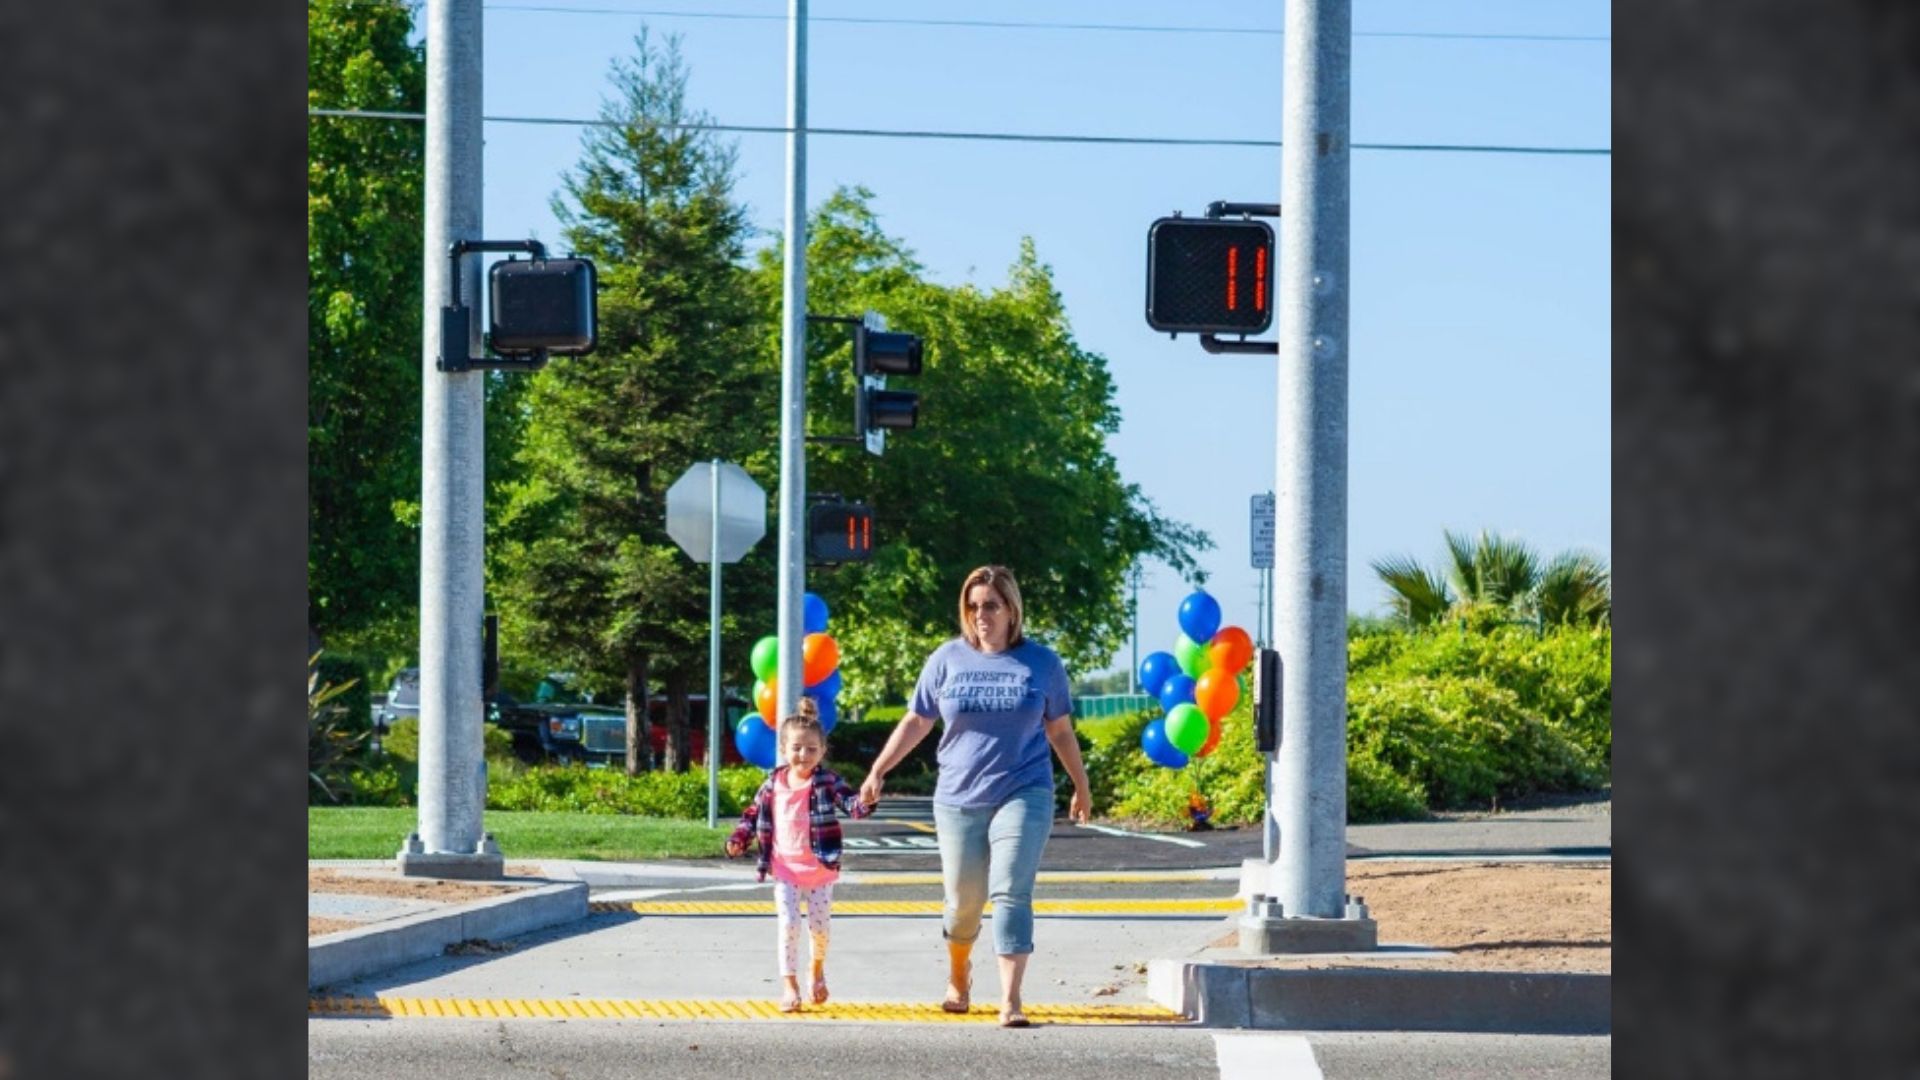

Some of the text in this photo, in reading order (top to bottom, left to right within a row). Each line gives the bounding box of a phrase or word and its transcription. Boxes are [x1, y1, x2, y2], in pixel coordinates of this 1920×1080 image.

[1207, 246, 1266, 310] 11
[848, 516, 870, 550] 11
[958, 698, 1015, 713] DAVIS
